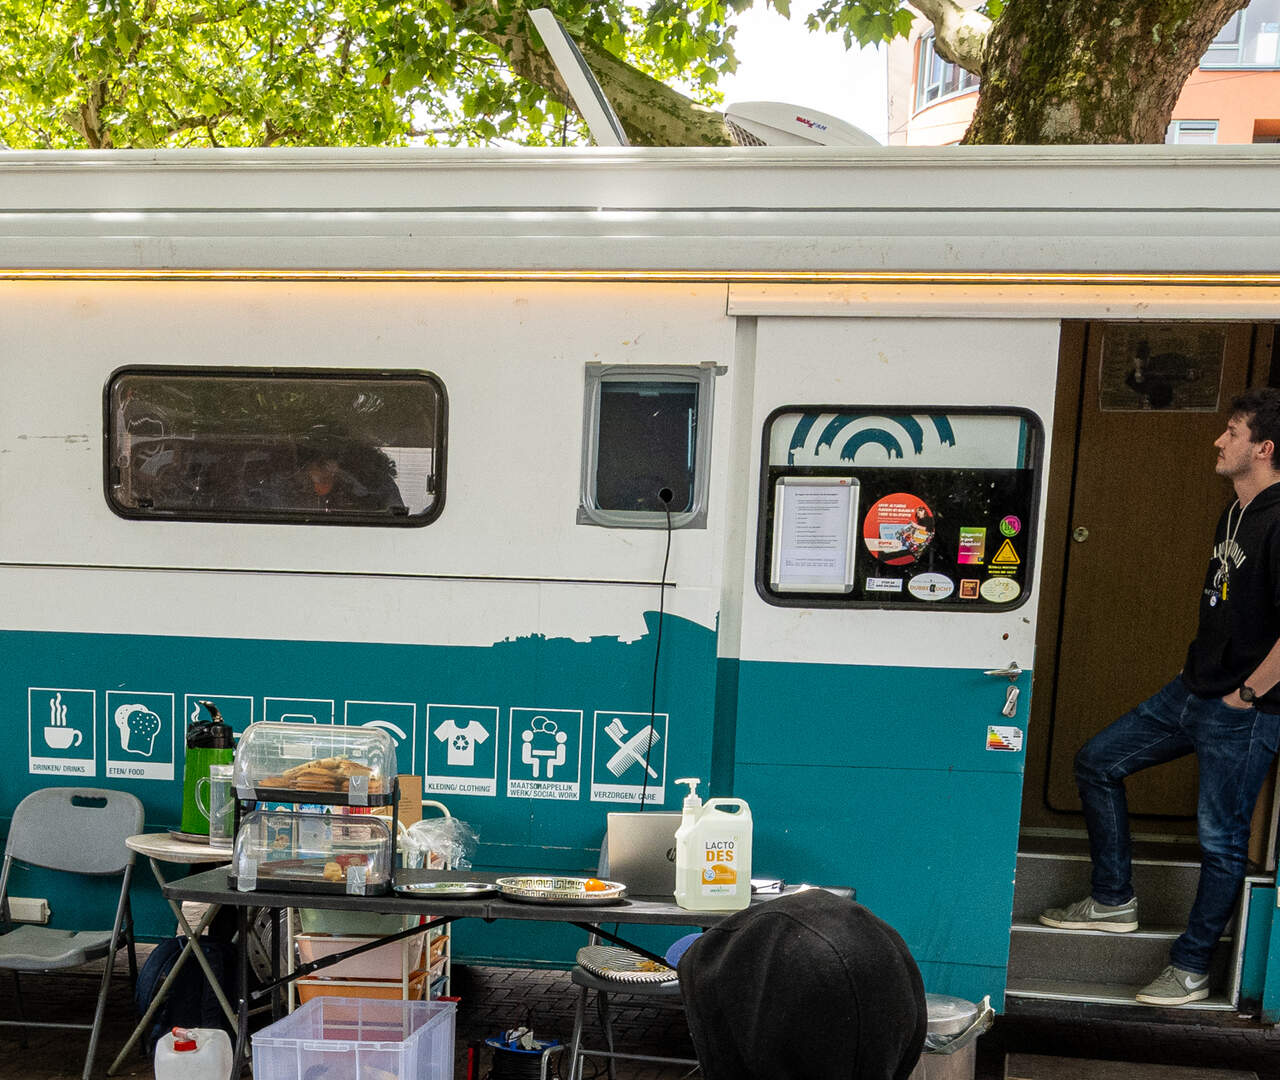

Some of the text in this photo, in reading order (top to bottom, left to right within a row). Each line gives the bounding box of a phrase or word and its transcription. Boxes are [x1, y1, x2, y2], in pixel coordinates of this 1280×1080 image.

[32, 763, 86, 774] DRINKEN/ DRINKS
[109, 767, 145, 776] ETEN/ FOOD
[428, 783, 491, 793] KLEDING/ CLOTHING
[510, 789, 578, 800] WERK/ SOCIAL WORK
[593, 791, 637, 801] VERZORGEN/
[705, 841, 735, 850] LACTO
[706, 850, 734, 862] DES
